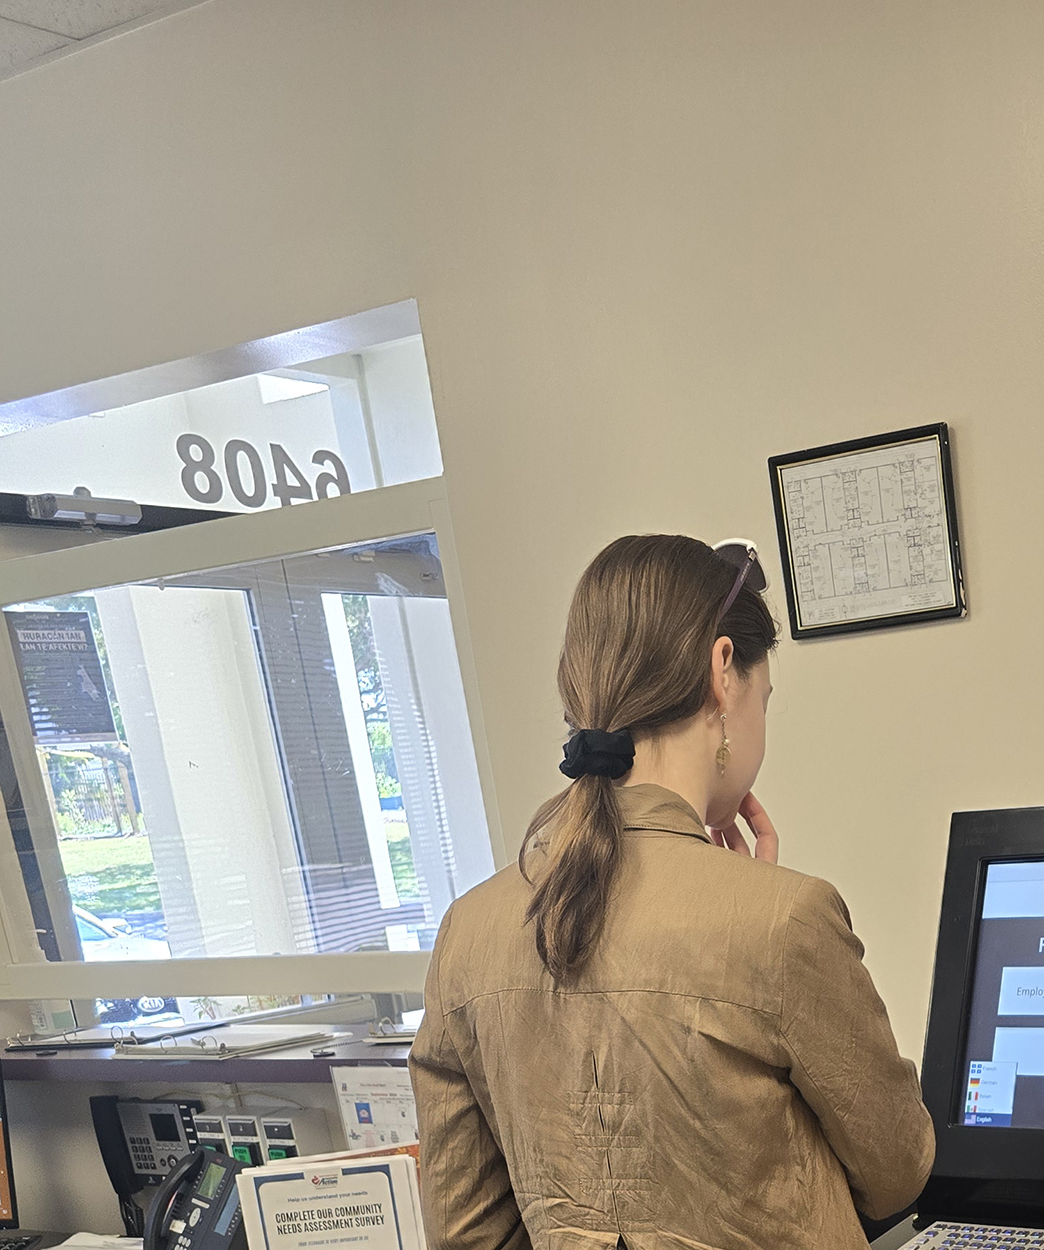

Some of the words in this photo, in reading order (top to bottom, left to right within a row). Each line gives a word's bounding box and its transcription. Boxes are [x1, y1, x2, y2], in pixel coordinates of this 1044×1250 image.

[140, 996, 163, 1010] KIA
[976, 1116, 993, 1124] English
[319, 1178, 338, 1186] Action
[275, 1209, 315, 1224] COMPLETE
[317, 1208, 333, 1219] OUR
[335, 1203, 383, 1218] COMMUNITY
[277, 1223, 303, 1236] NEEDS
[304, 1218, 354, 1233] ASSESSMENT
[355, 1215, 385, 1228] SURVEY
